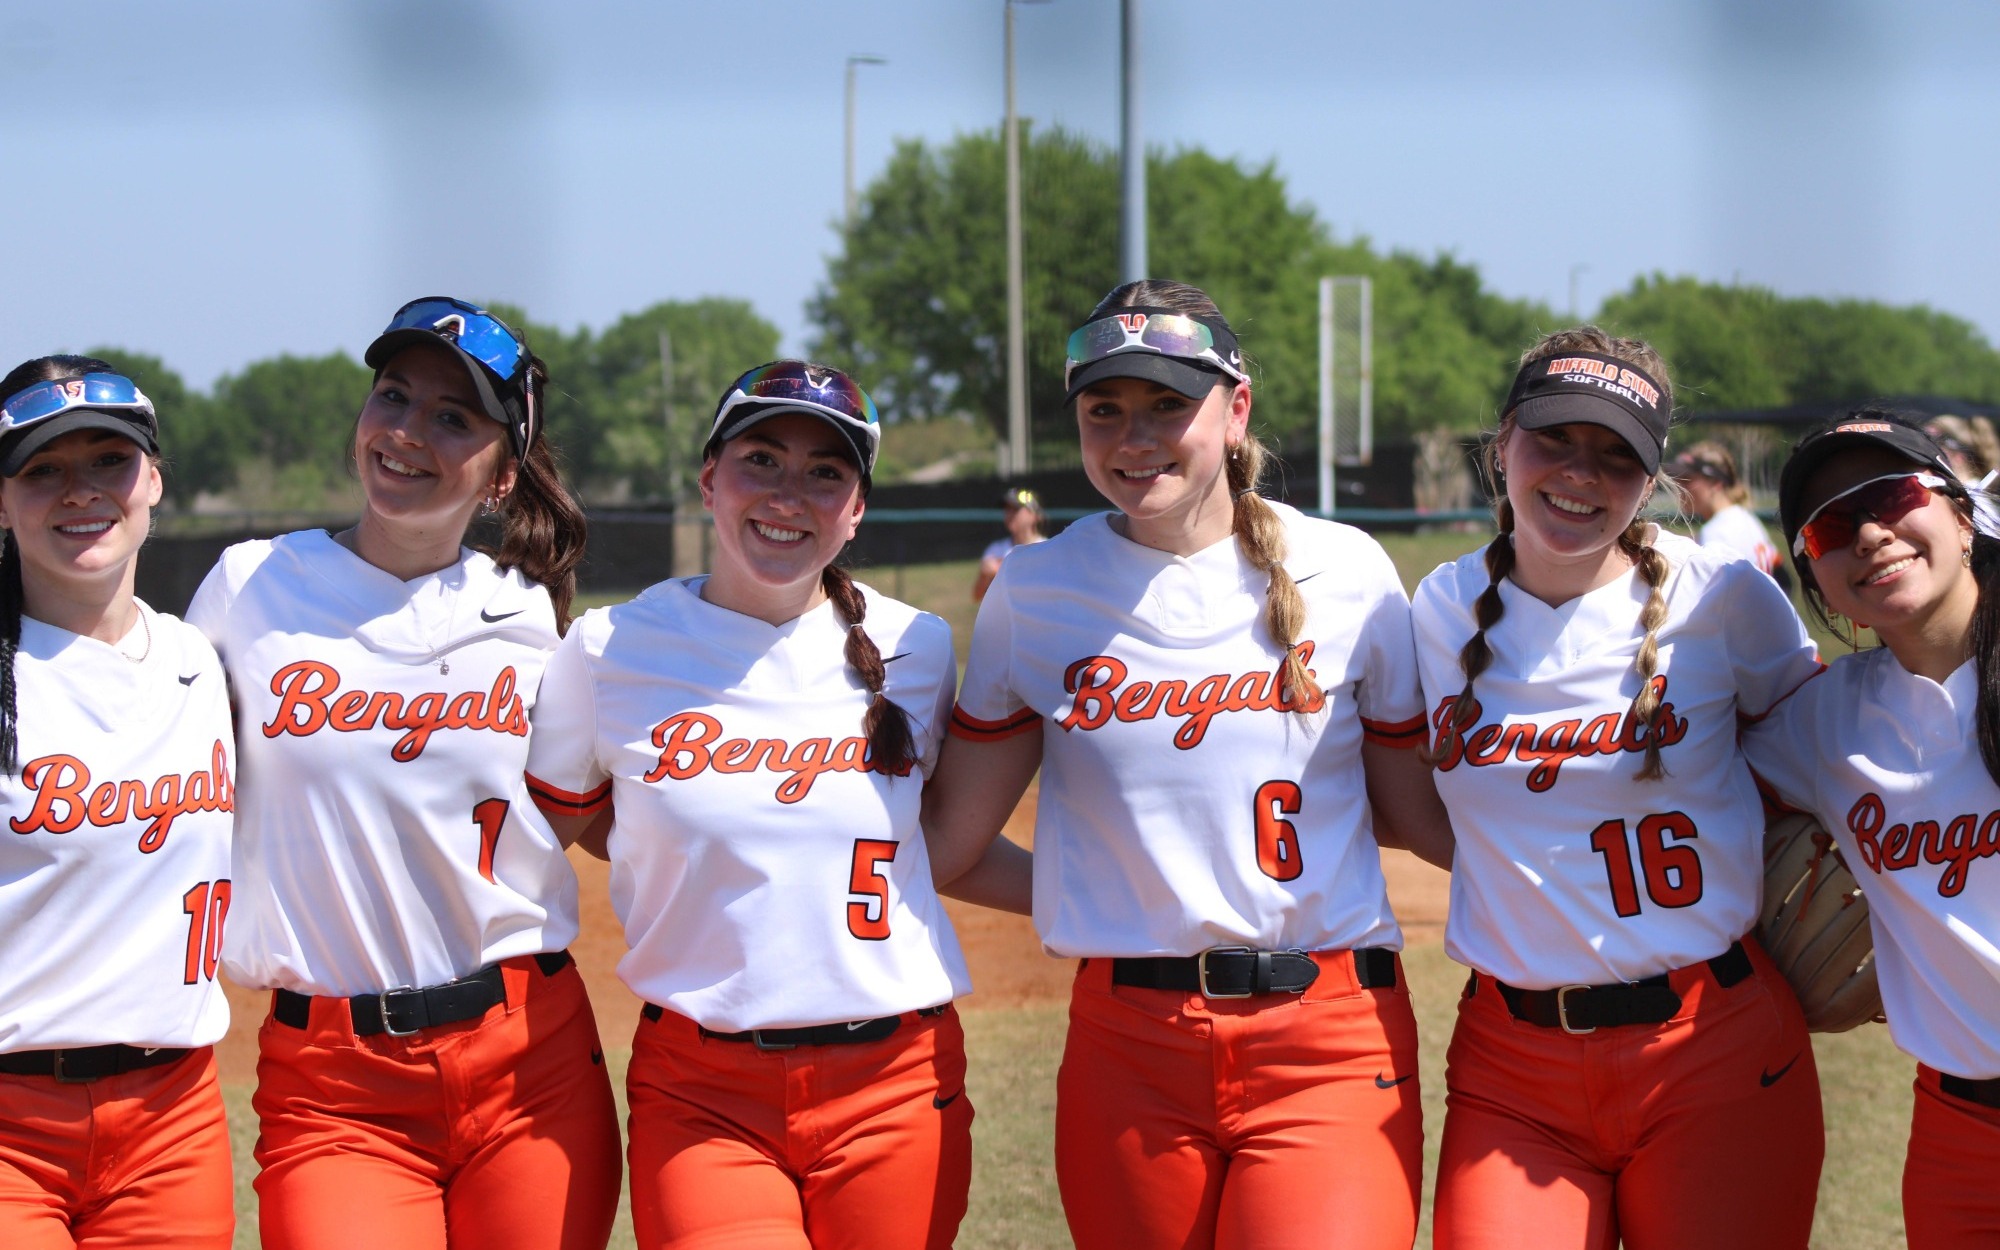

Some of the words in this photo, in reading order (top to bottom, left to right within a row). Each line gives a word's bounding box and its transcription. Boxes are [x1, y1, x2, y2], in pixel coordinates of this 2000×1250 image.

[1546, 357, 1619, 381] BUFFALO
[1618, 368, 1660, 410] STATE
[1562, 374, 1643, 409] SOFTBALL
[262, 660, 528, 763] Bengals
[643, 712, 912, 804] Benga
[472, 798, 510, 885] 1
[1253, 780, 1302, 881] 6
[1590, 811, 1703, 917] 16
[183, 879, 232, 985] 10
[846, 838, 899, 940] 5
